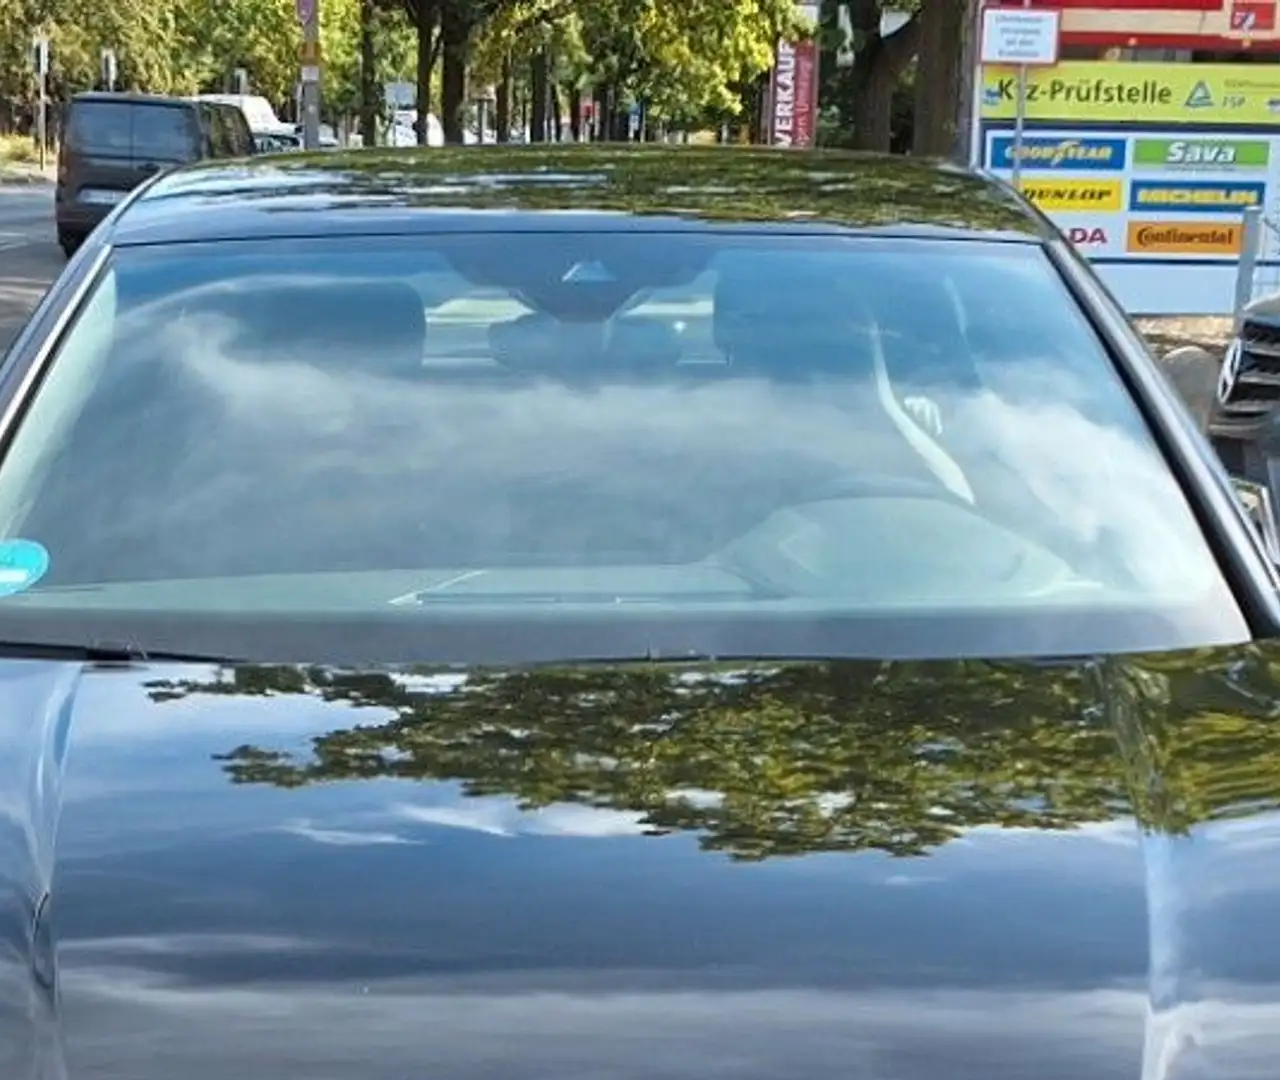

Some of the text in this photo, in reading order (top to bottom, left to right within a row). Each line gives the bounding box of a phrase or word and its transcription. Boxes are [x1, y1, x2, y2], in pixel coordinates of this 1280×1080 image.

[998, 78, 1172, 104] Kz-Prüfstelle
[1167, 142, 1236, 164] Sava
[1137, 227, 1233, 247] Continental
